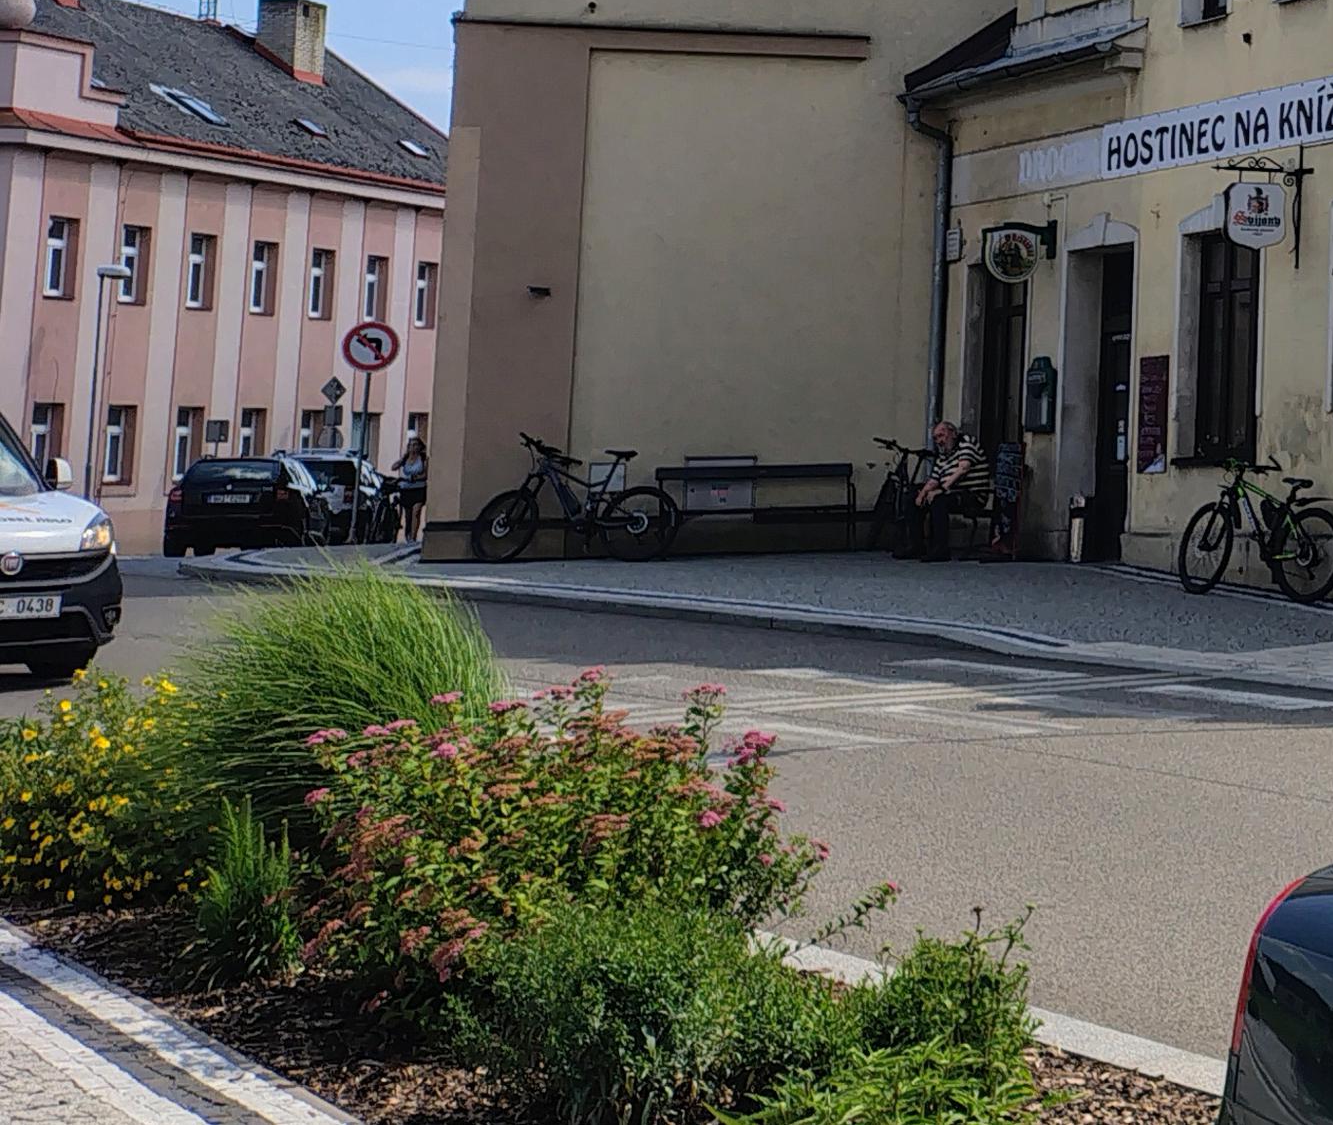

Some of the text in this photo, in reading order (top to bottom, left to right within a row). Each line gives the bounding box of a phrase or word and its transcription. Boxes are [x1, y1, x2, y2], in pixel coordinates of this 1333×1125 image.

[1107, 114, 1227, 172] HOSTINEC
[1234, 107, 1270, 149] NA
[16, 598, 54, 614] 0438
